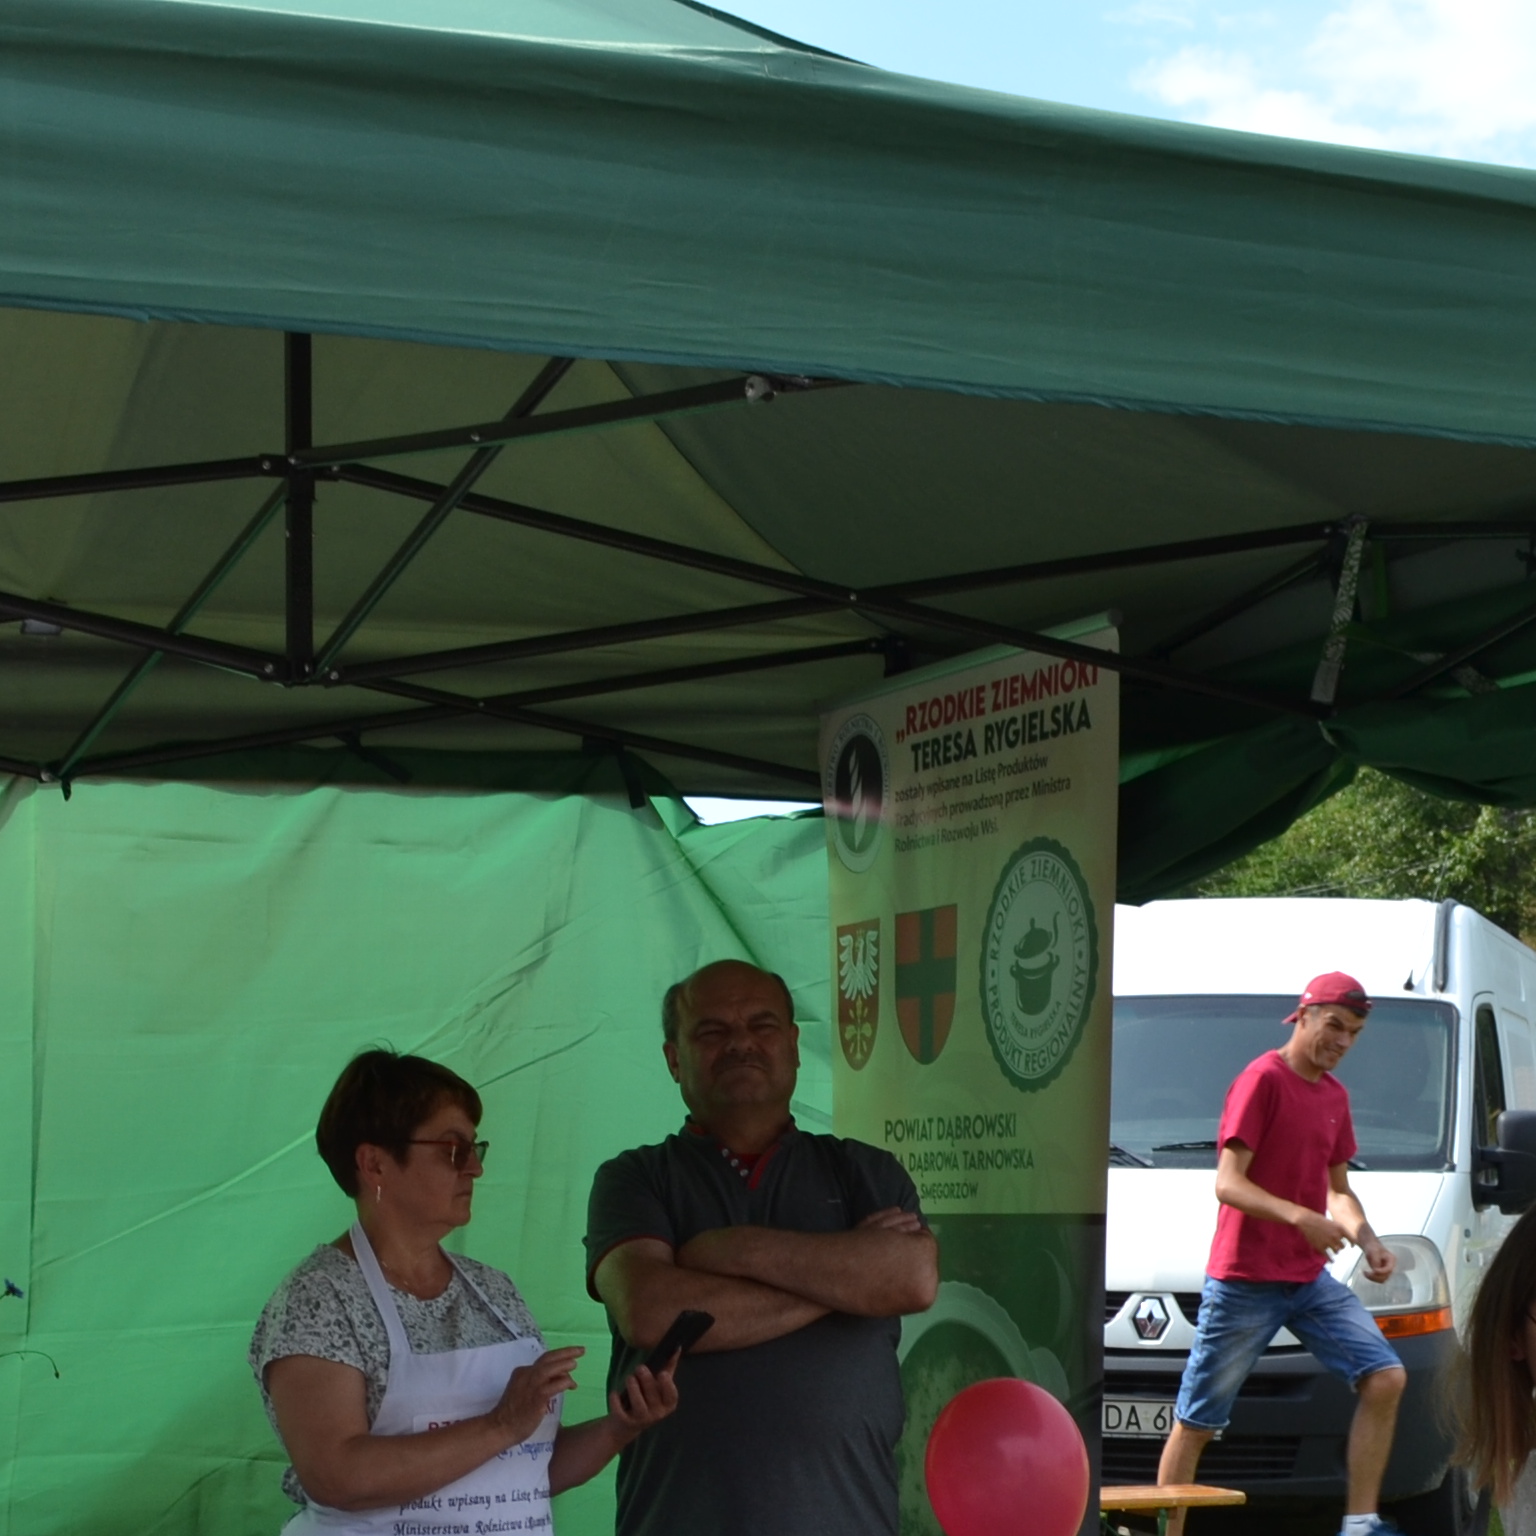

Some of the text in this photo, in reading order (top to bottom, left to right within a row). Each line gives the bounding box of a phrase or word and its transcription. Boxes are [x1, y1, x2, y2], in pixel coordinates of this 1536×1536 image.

[911, 729, 977, 773] TERESA
[984, 698, 1091, 755] RYGIELSKA
[894, 754, 1048, 804] zostały wpisane na Listę Produktów
[949, 791, 1004, 817] prowadzoną
[1005, 786, 1030, 807] przez
[1031, 776, 1072, 798] Ministra
[894, 831, 936, 853] Rolnictwa
[940, 823, 979, 844] Rozwoju
[990, 858, 1085, 961] RZODKIE ZIEMNIOKI
[988, 969, 1086, 1073] PRODUKT REGIONALNY
[884, 1113, 1016, 1147] POWIAT DĄBROWSKI
[908, 1151, 959, 1178] DĄBROWA
[962, 1149, 1034, 1171] TARNOWSKA
[1153, 1405, 1175, 1431] 6
[399, 1495, 443, 1515] produkt
[448, 1492, 491, 1512] wpisany
[495, 1492, 506, 1504] na
[511, 1489, 530, 1503] Listę
[393, 1523, 469, 1536] Ministerstwa
[475, 1518, 522, 1536] Rolnictwa
